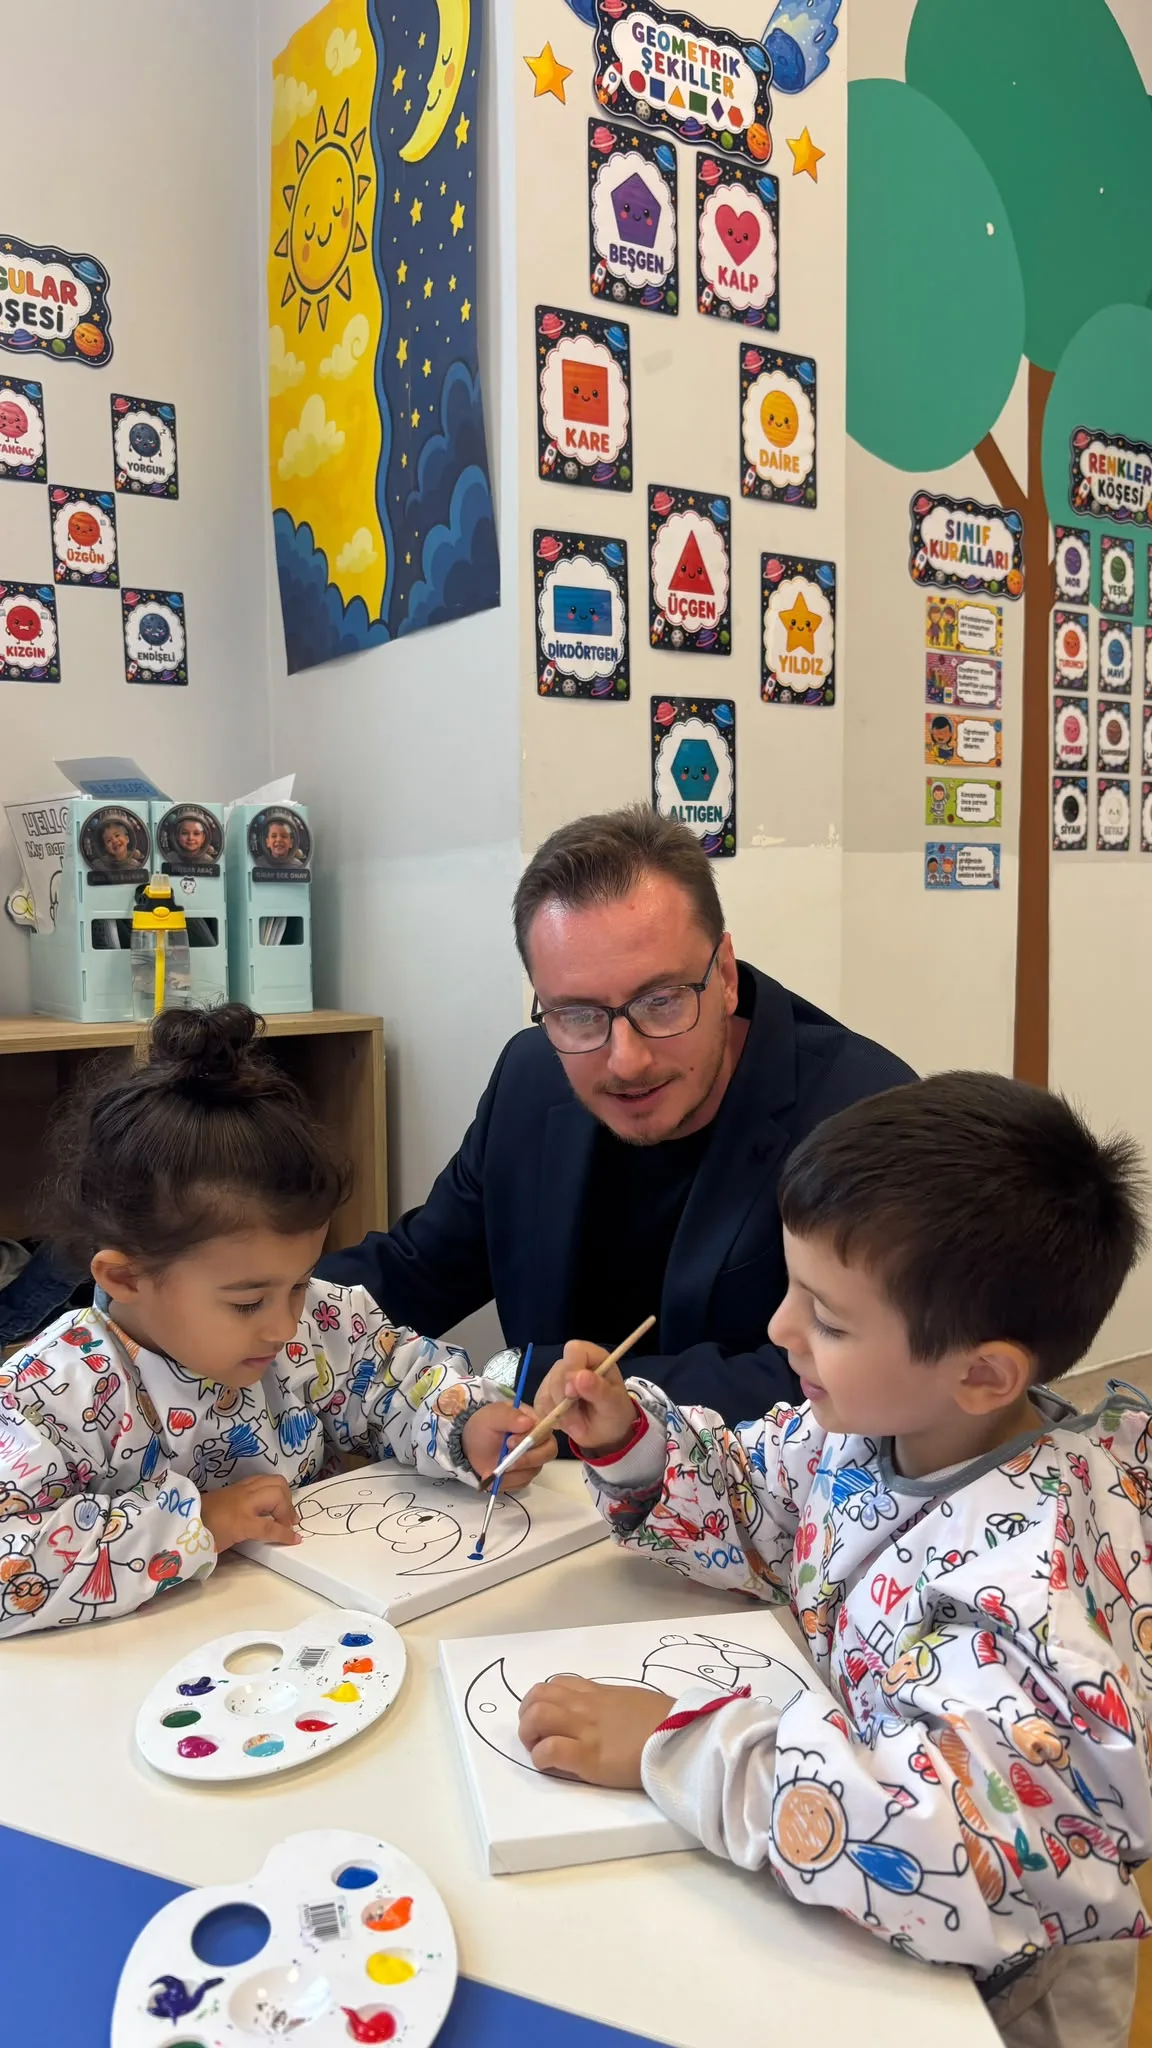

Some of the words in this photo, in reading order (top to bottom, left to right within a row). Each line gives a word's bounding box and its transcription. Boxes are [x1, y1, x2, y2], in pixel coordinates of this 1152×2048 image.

[641, 47, 734, 100] ŞEKİLLER
[609, 243, 664, 274] BEŞGEN
[718, 266, 759, 293] KALP
[0, 298, 63, 333] ŞESİ
[0, 443, 34, 459] ANGAÇ
[565, 427, 610, 453] KARE
[126, 460, 166, 476] YORGUN
[759, 449, 800, 474] DAİRE
[1088, 452, 1152, 487] RENKLER
[1098, 477, 1144, 507] KÖŞESİ
[945, 519, 991, 544] SINIF
[66, 548, 105, 565] ÜZGÜN
[929, 538, 1009, 571] KURALLARI
[1065, 577, 1081, 588] MOR
[667, 592, 716, 620] ÜÇGEN
[6, 646, 46, 658] KIZGIN
[137, 649, 176, 665] ENDİŞELİ
[547, 641, 618, 662] DİKDÖRTGEN
[778, 655, 824, 676] YILDIZ
[670, 805, 723, 823] ALTIGEN
[25, 841, 44, 860] My
